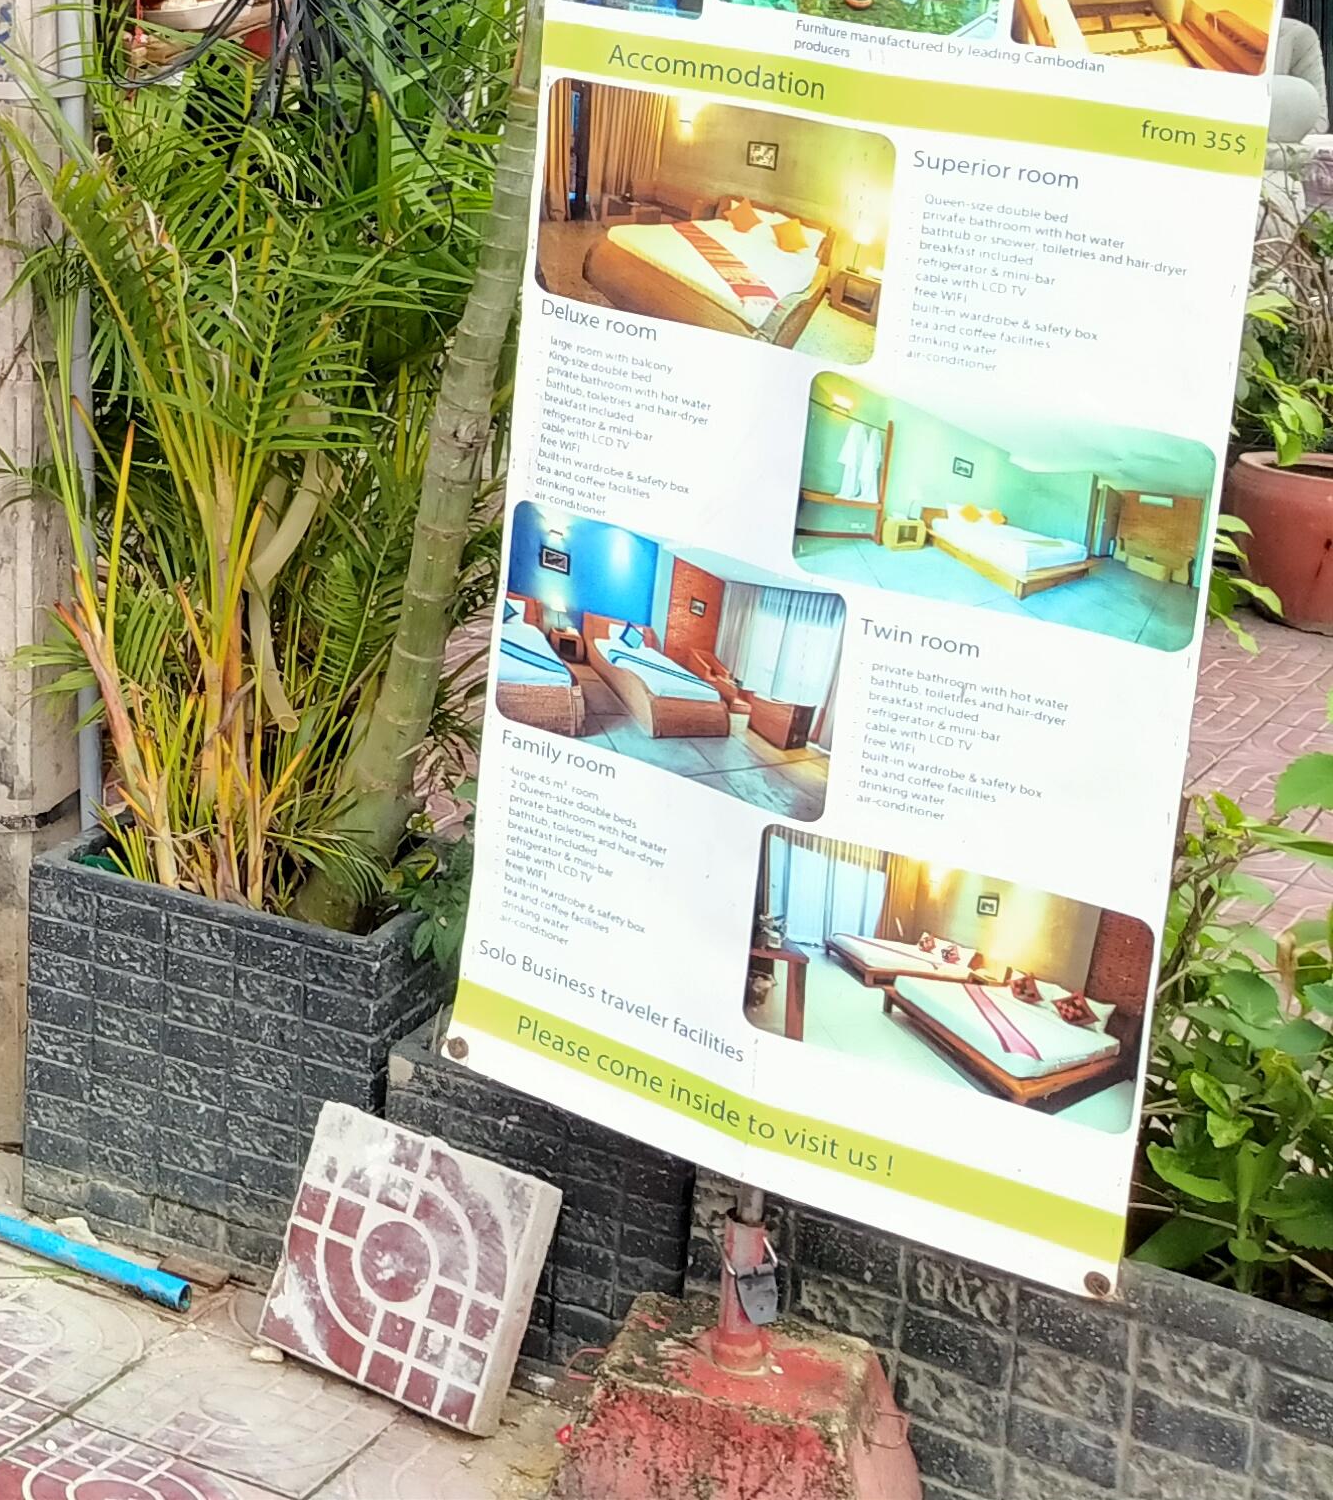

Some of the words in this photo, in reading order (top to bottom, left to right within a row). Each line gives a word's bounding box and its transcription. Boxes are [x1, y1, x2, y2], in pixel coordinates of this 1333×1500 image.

[793, 39, 850, 58] producers
[795, 19, 848, 39] Furniture
[850, 32, 944, 52] manufactured
[947, 42, 964, 57] by
[967, 45, 1020, 64] leading
[1024, 51, 1104, 72] Cambodian
[607, 45, 825, 99] Accommodation
[1141, 119, 1196, 146] from
[1203, 130, 1246, 155] 35$
[913, 150, 1011, 178] Superior
[1018, 168, 1079, 189] room
[924, 194, 994, 212] Queen-size
[996, 204, 1041, 219] double
[1044, 210, 1069, 224] bed
[922, 211, 965, 224] private
[969, 215, 1031, 233] bathroom
[1035, 227, 1062, 238] with
[1064, 229, 1086, 243] hot
[1089, 236, 1125, 249] water
[919, 240, 975, 256] breakfast
[979, 251, 1033, 265] included
[920, 224, 971, 240] bathtub
[973, 234, 987, 242] or
[1042, 243, 1096, 260] toiletries
[1099, 253, 1123, 265] and
[1125, 255, 1187, 276] hair-dryer
[915, 273, 949, 284] cable
[951, 278, 979, 289] with
[981, 282, 1007, 294] LCD
[1011, 285, 1027, 297] TV
[917, 257, 987, 274] refrigerator
[990, 266, 999, 277] &
[1002, 270, 1056, 285] mini-bar
[541, 299, 600, 328] Deluxe
[605, 319, 657, 341] room
[910, 318, 929, 329] tea
[932, 323, 956, 333] and
[959, 327, 997, 340] coffee
[1000, 331, 1051, 348] facilities
[911, 301, 955, 316] built-in
[959, 312, 1019, 327] wardrobe
[1021, 319, 1031, 329] &
[1035, 323, 1071, 338] safety
[1074, 327, 1097, 340] box
[550, 335, 573, 351] large
[576, 345, 603, 357] room
[605, 353, 628, 363] with
[631, 356, 673, 374] balcony
[860, 617, 912, 644] Twin
[920, 635, 980, 658] room
[868, 691, 923, 710] breakfast
[926, 705, 979, 722] included
[871, 663, 914, 678] private
[916, 670, 977, 689] bathroom
[980, 686, 1007, 697] with
[1009, 689, 1031, 703] hot
[1034, 697, 1069, 711] water
[925, 688, 977, 706] toiletries
[979, 700, 1003, 712] and
[1006, 703, 1066, 726] hair-dryer
[502, 729, 562, 764] Family
[566, 753, 616, 779] room
[865, 722, 897, 735] cable
[900, 730, 926, 741] with
[929, 733, 954, 747] LCD
[958, 739, 973, 751] TV
[861, 749, 904, 767] built-in
[907, 762, 966, 780] wardrobe
[968, 773, 977, 783] &
[980, 777, 1017, 793] safety
[1019, 784, 1042, 798] box
[479, 939, 517, 966] Solo
[521, 955, 595, 998] Business
[601, 989, 669, 1027] traveler
[673, 1017, 744, 1062] facilities
[517, 1015, 590, 1062] Please
[596, 1054, 663, 1093] come
[670, 1078, 740, 1125] inside
[747, 1114, 775, 1137] to
[783, 1128, 839, 1159] visit
[848, 1148, 877, 1171] us
[886, 1154, 893, 1177] !
